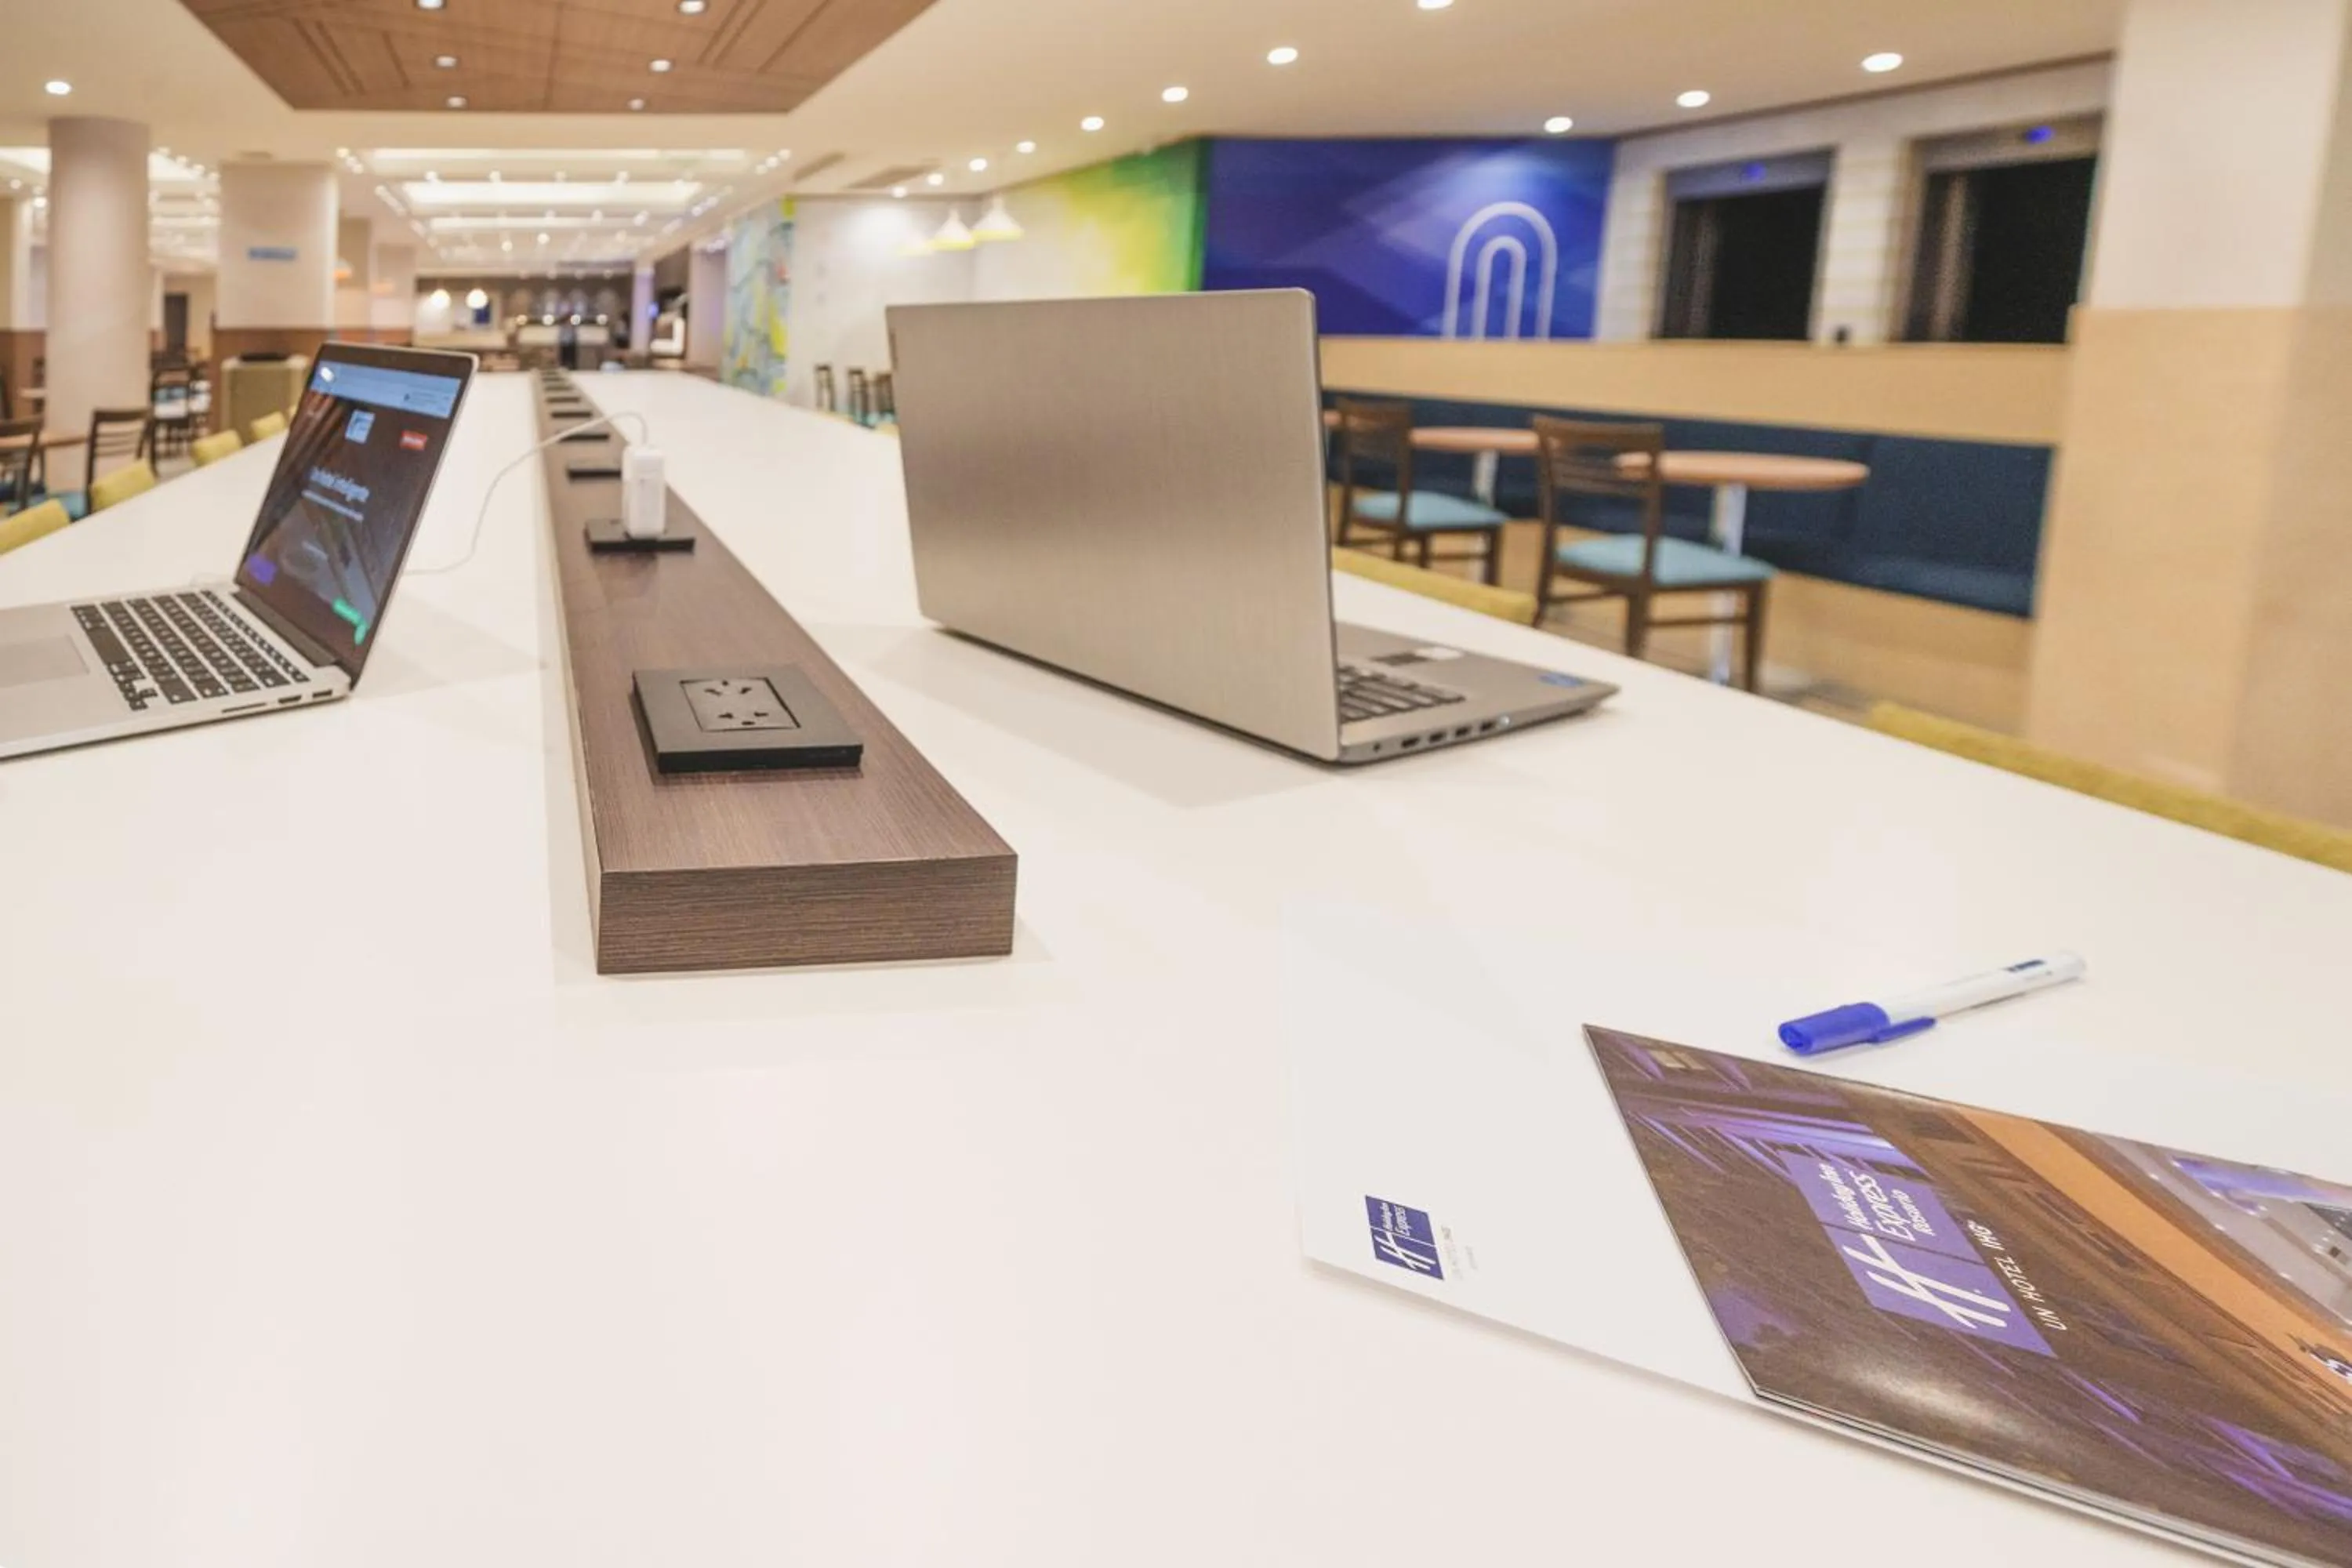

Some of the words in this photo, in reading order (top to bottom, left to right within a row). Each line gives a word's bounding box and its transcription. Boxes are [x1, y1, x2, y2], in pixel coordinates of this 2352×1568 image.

[1849, 1170, 1915, 1241] Express
[1967, 1220, 2005, 1250] IHG
[1994, 1257, 2045, 1303] HOTEL
[2031, 1305, 2067, 1330] UN
